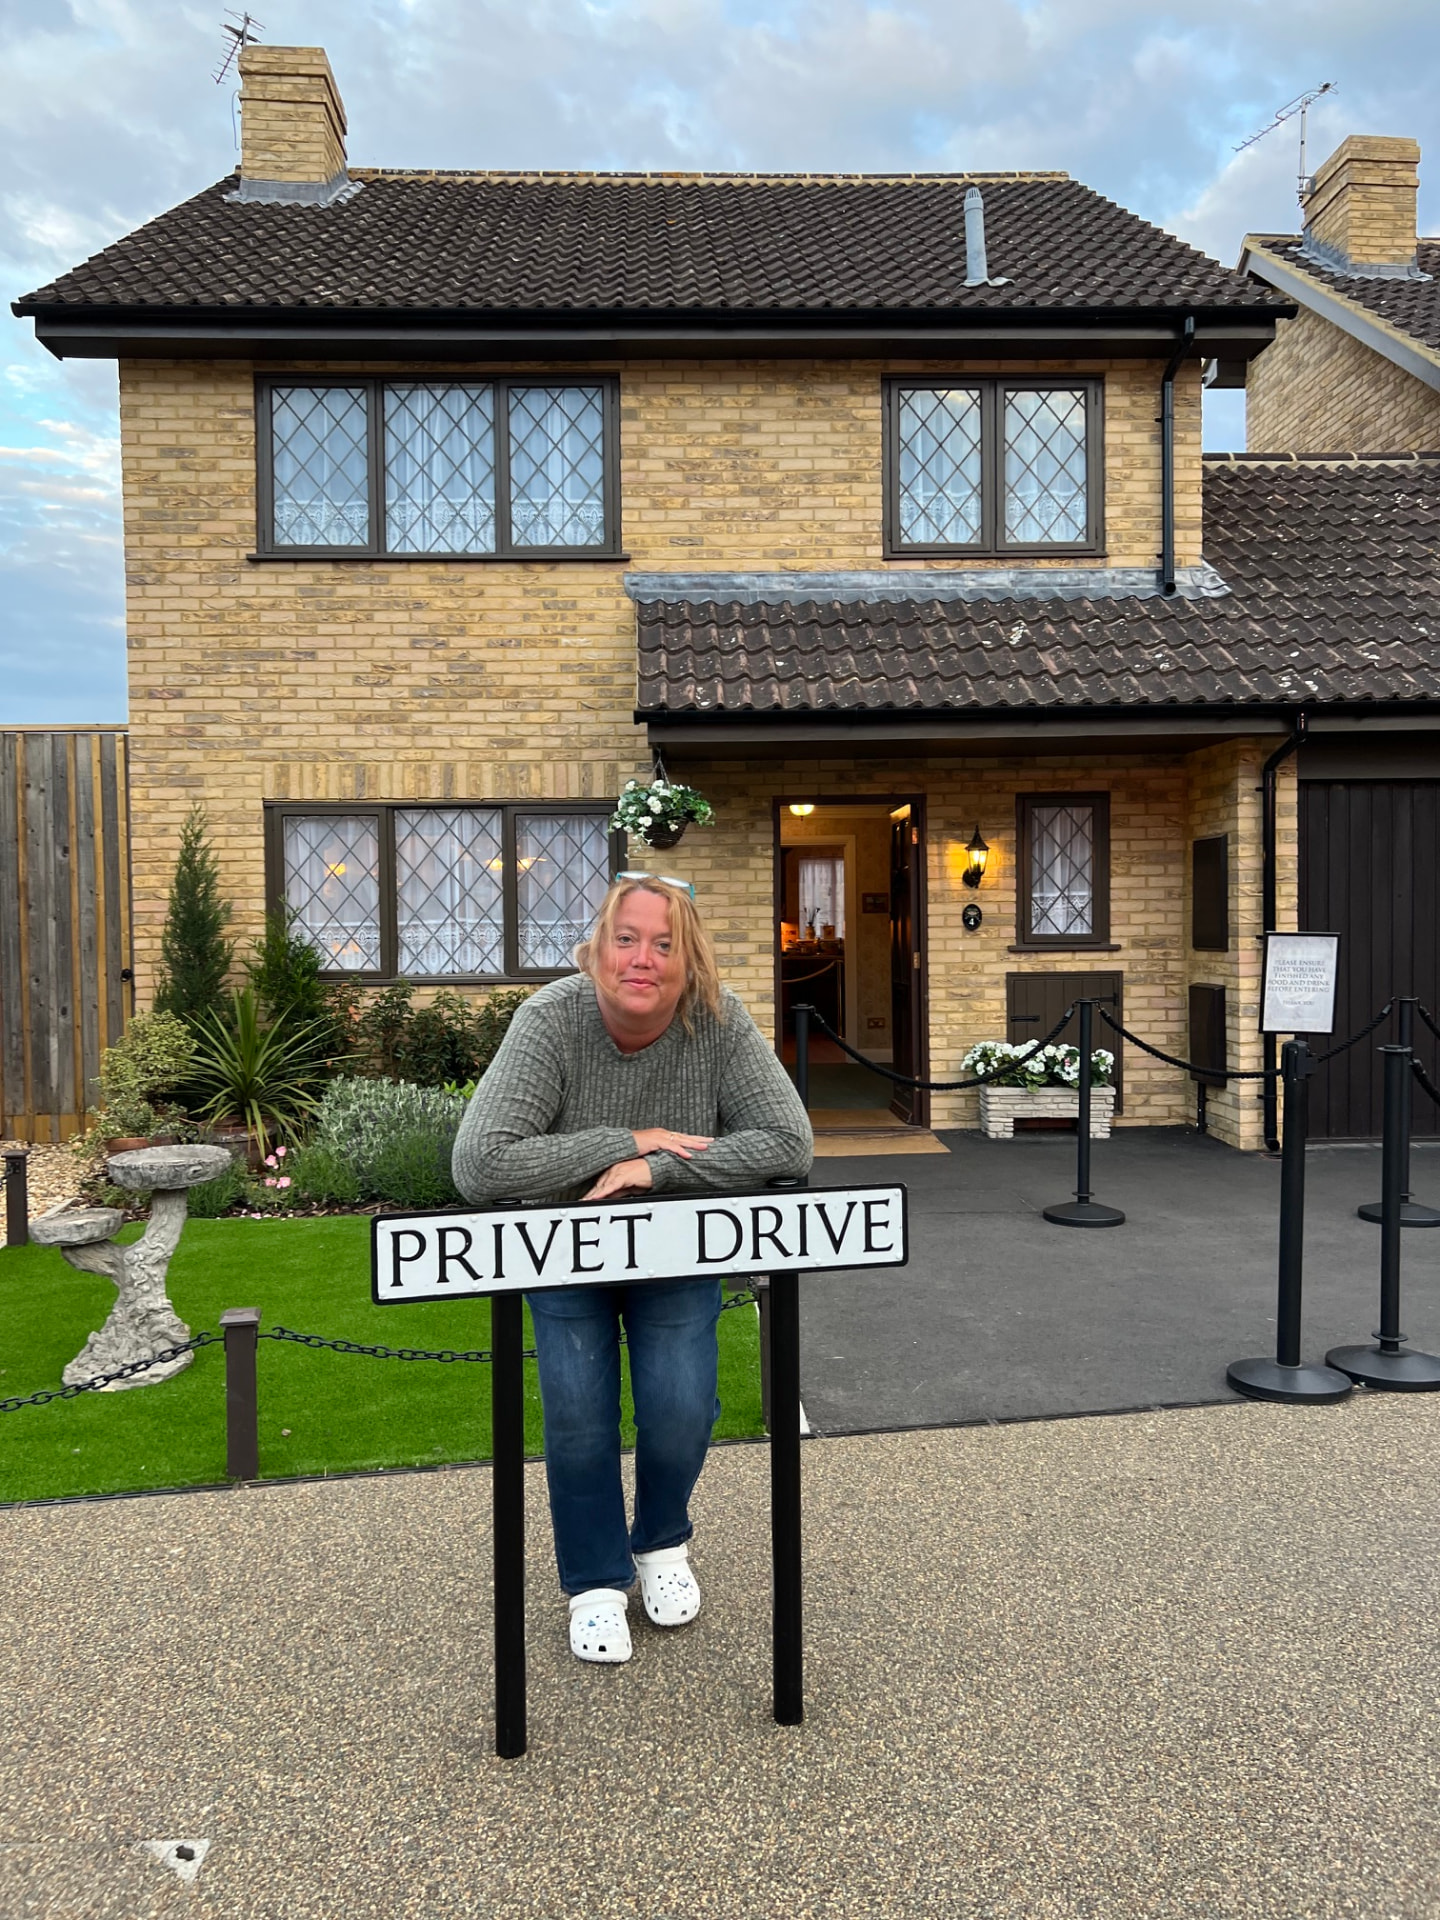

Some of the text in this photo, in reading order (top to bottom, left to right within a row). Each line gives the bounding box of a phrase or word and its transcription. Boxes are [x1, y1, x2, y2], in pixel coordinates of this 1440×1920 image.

[968, 917, 975, 926] 4
[389, 1198, 894, 1287] PRIVET DRIVE
